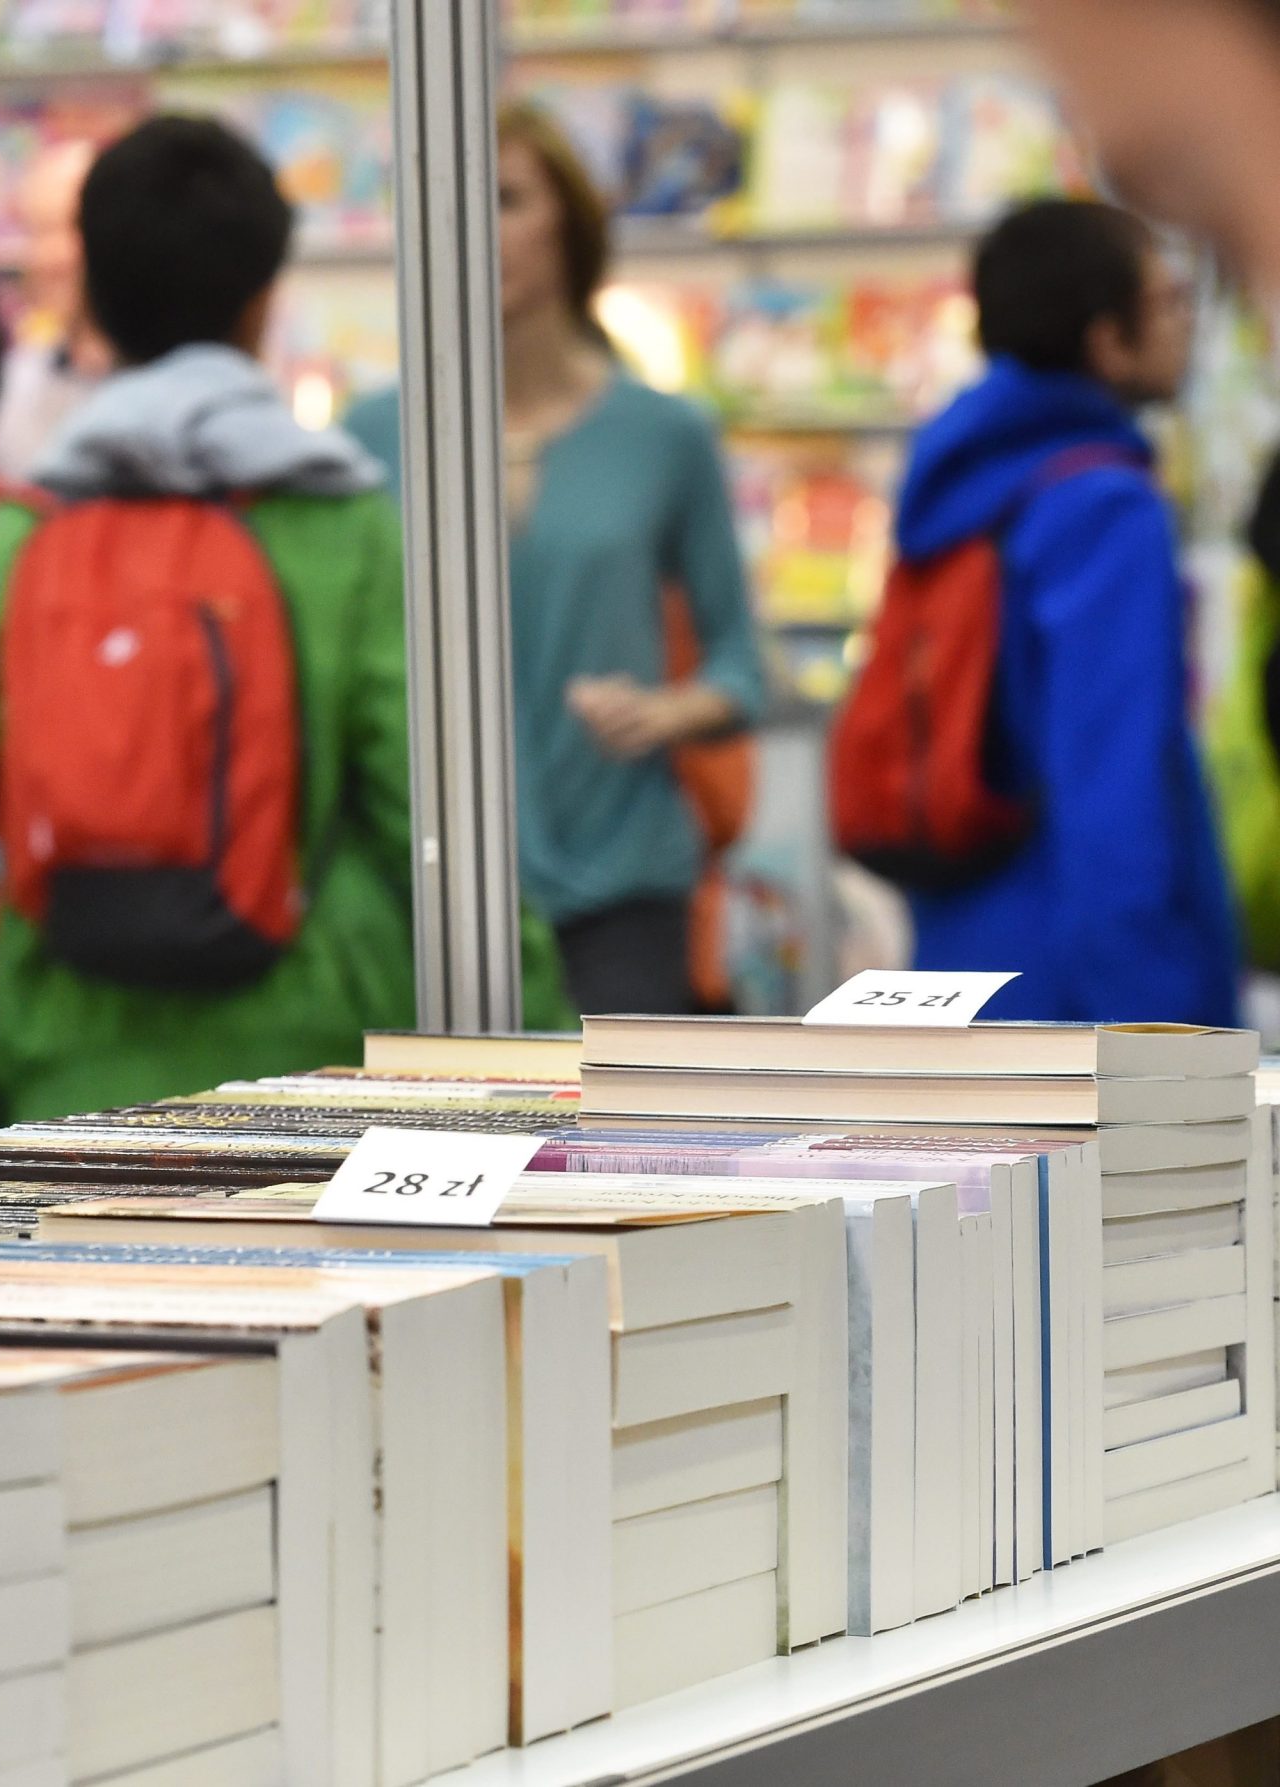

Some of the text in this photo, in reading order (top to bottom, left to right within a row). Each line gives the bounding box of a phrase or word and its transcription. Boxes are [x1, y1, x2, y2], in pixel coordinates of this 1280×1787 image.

[852, 991, 963, 1007] 25 zł
[362, 1171, 487, 1197] 28 zł
